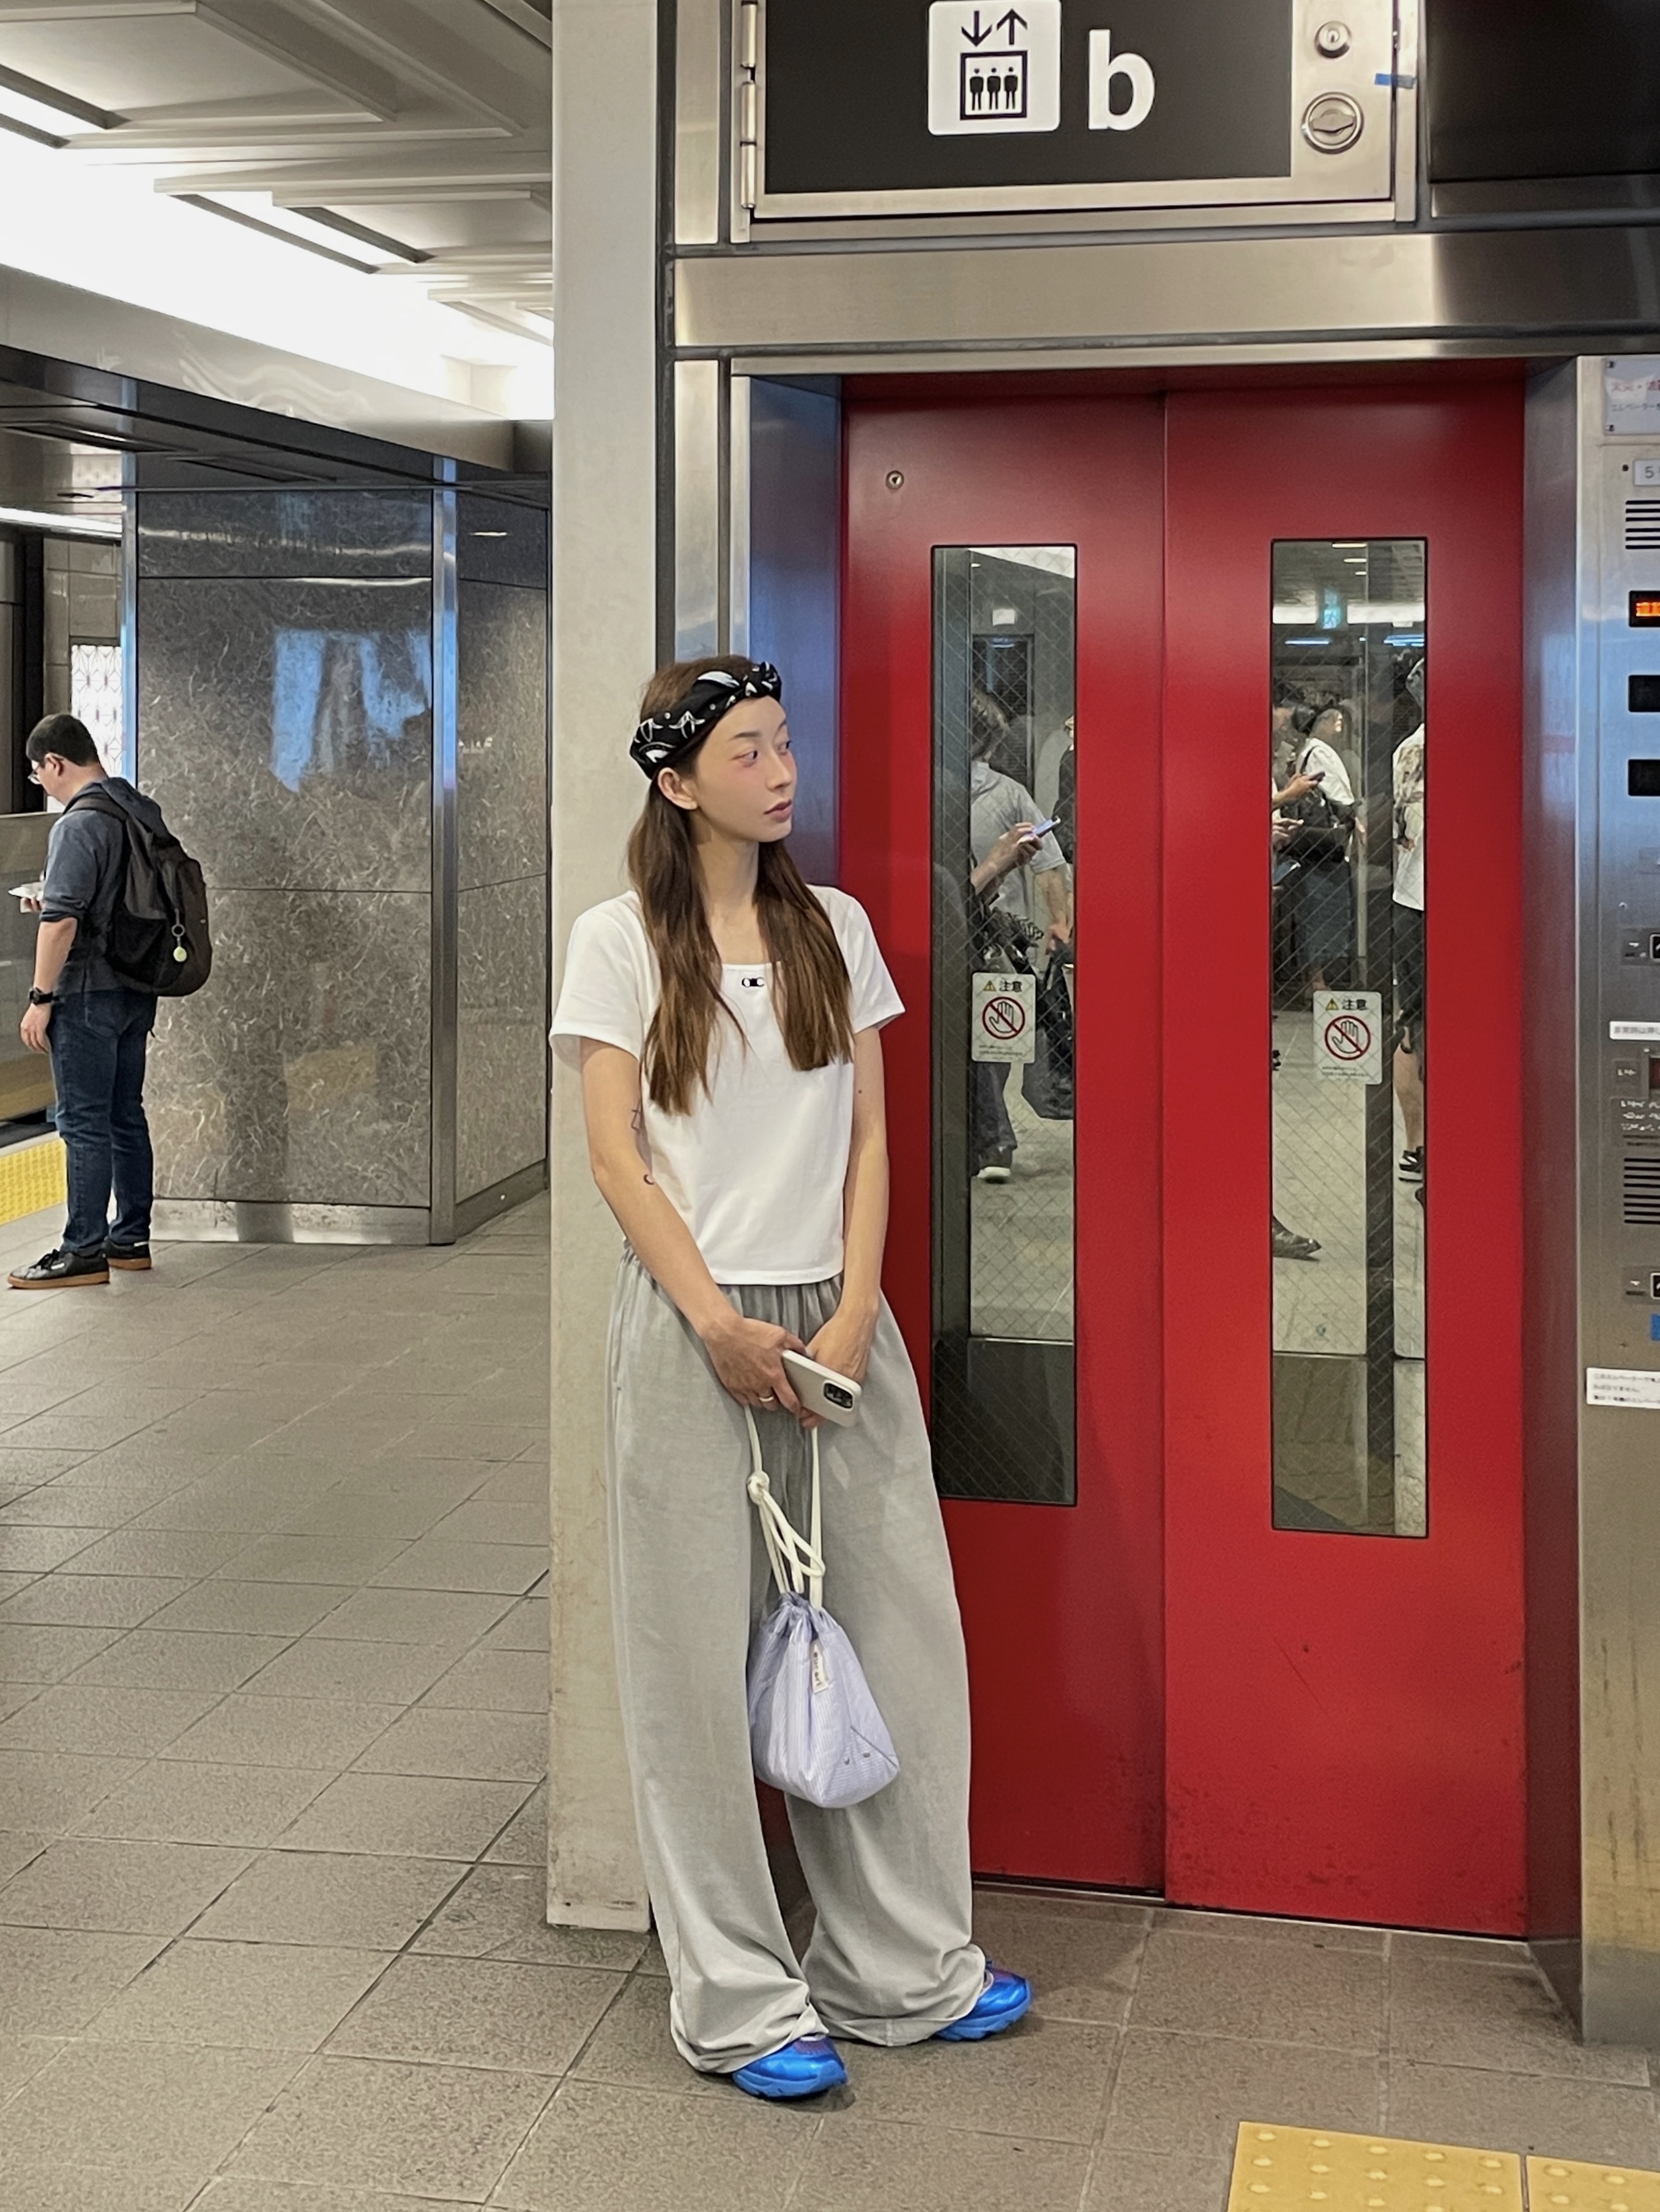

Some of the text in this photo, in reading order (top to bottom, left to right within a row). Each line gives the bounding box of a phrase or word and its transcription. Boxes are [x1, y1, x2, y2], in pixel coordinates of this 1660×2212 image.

[1089, 29, 1155, 131] b
[1645, 466, 1660, 480] 5
[999, 980, 1022, 992] 注意
[1341, 998, 1368, 1011] 注意
